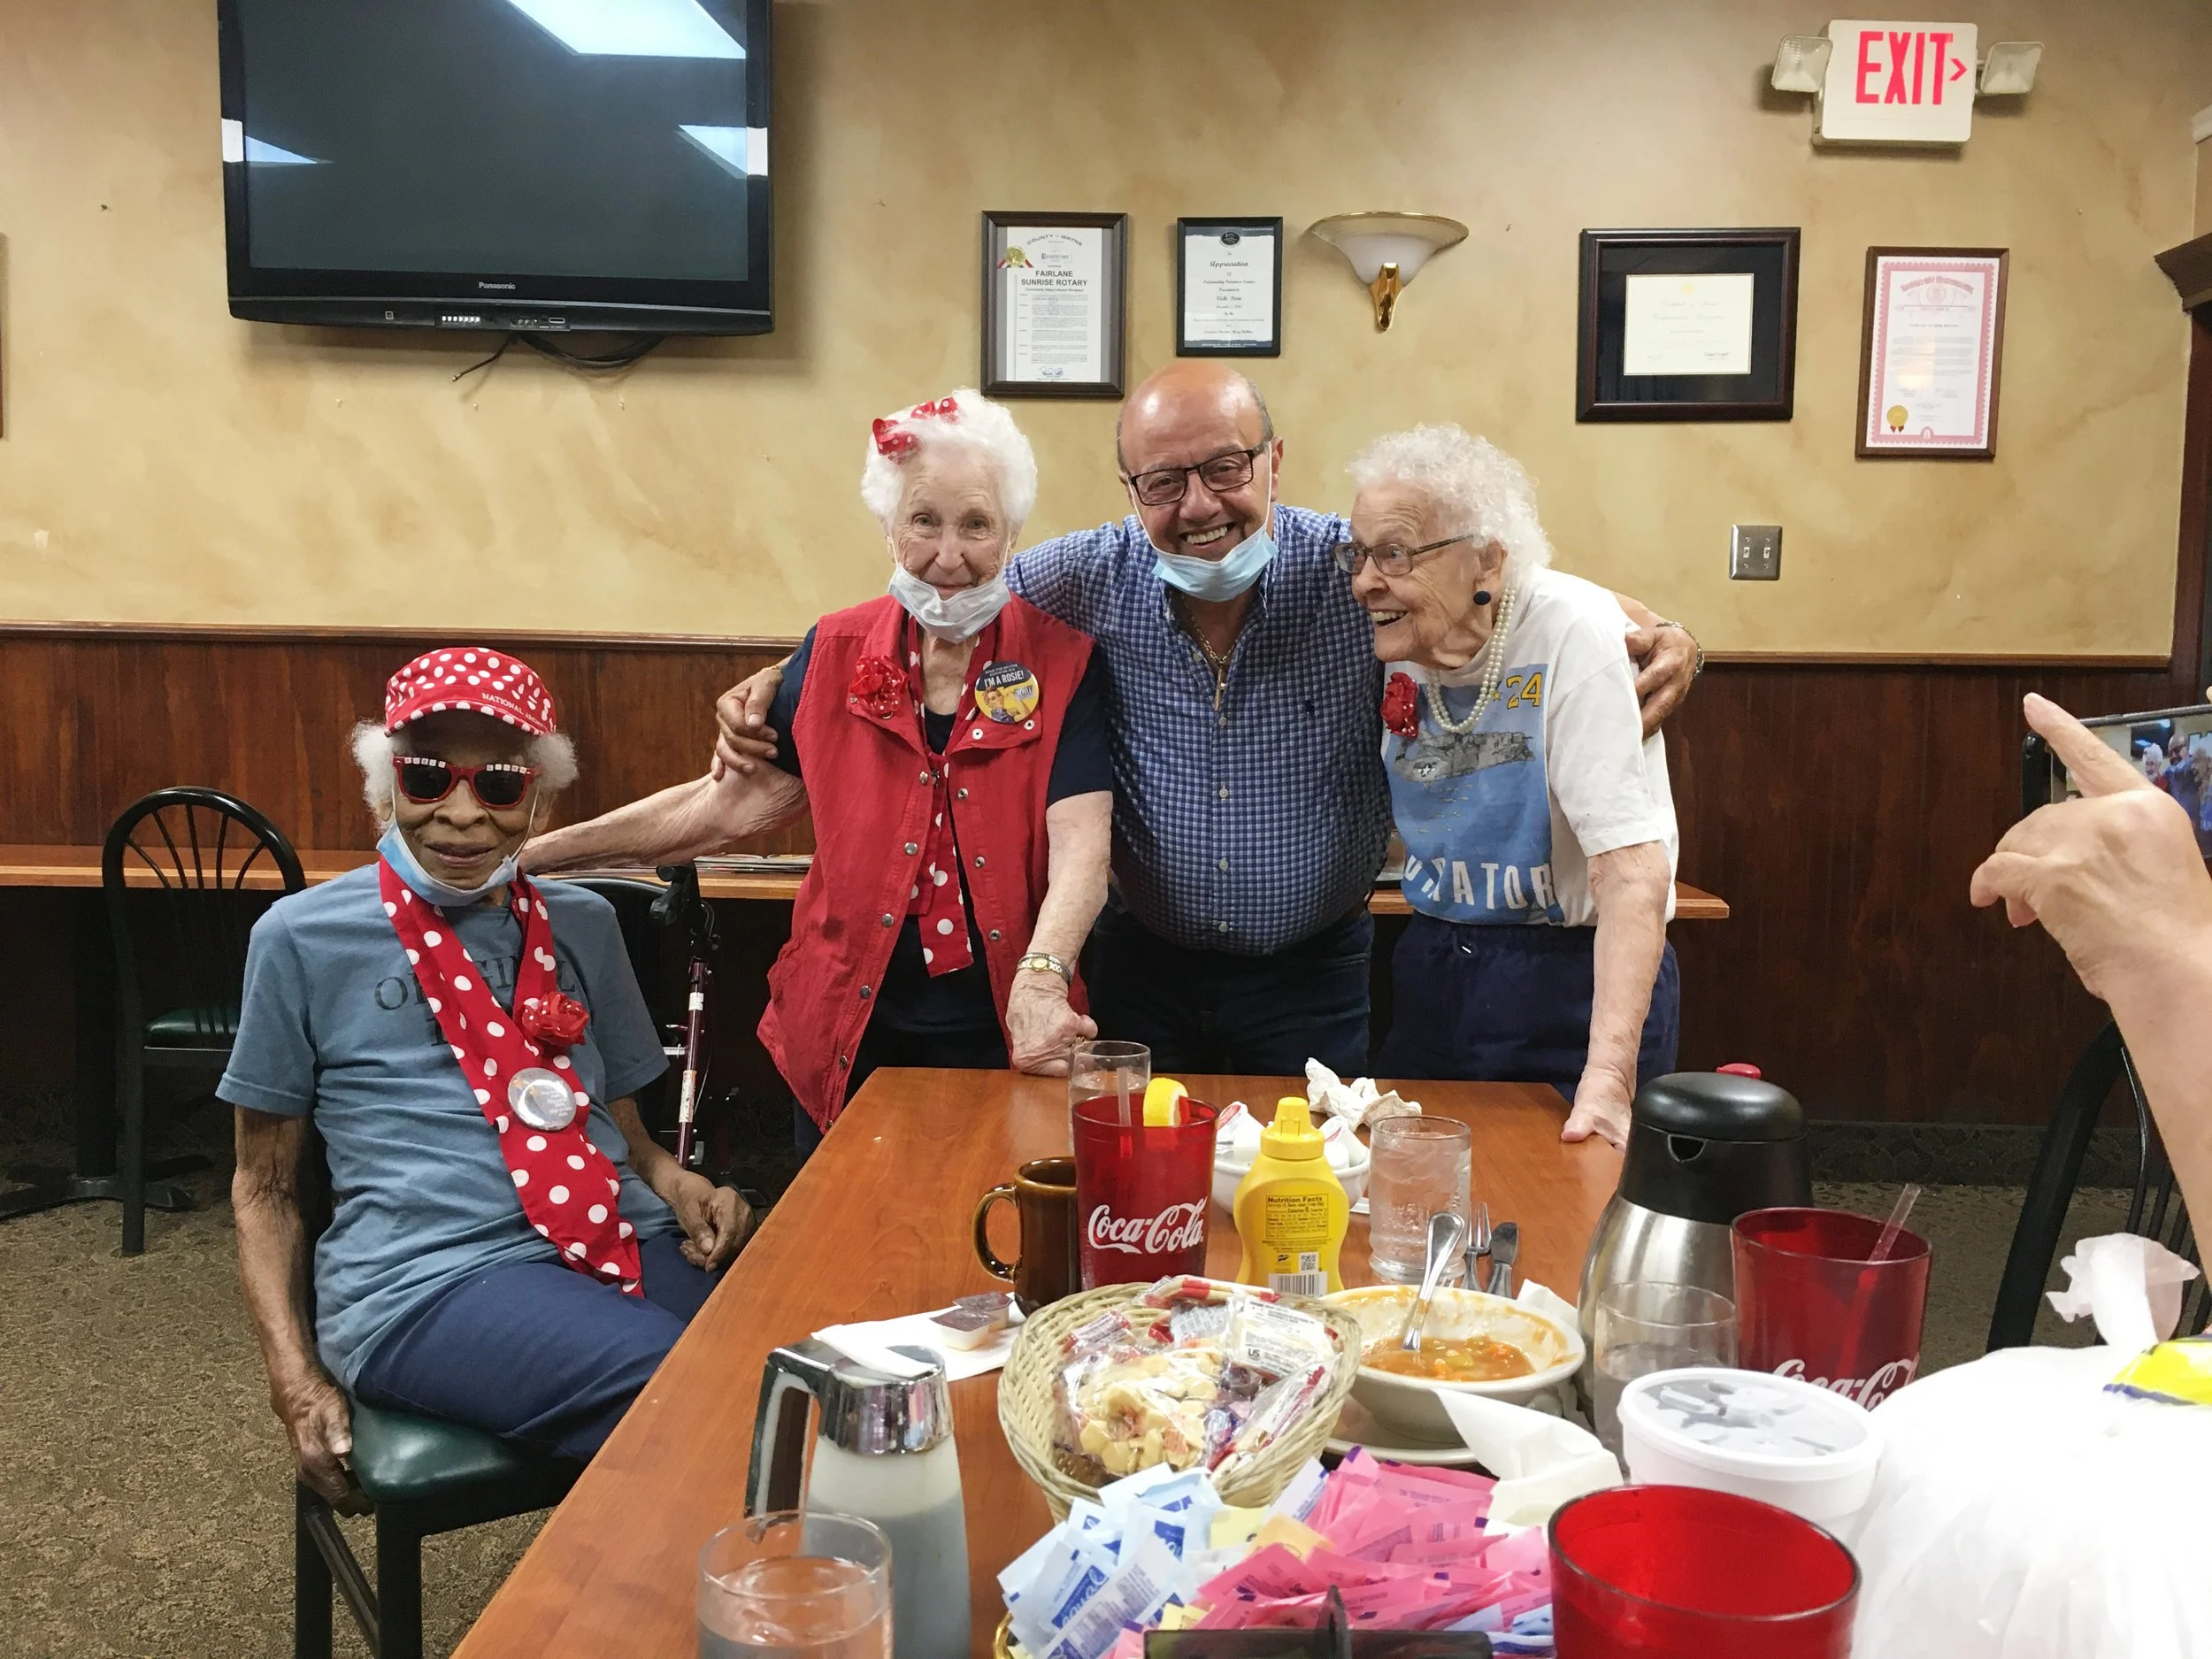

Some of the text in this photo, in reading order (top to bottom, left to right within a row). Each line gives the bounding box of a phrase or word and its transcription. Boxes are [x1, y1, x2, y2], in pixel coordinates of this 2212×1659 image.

[1855, 30, 1955, 105] EXIT
[1026, 233, 1083, 247] COUNTY WAYNE
[984, 677, 995, 687] I'M
[996, 675, 1002, 686] A
[1002, 670, 1025, 683] ROSIE!
[1505, 672, 1543, 709] 24
[481, 692, 524, 715] NATIONAL
[1087, 1195, 1208, 1255] Coca-Cola
